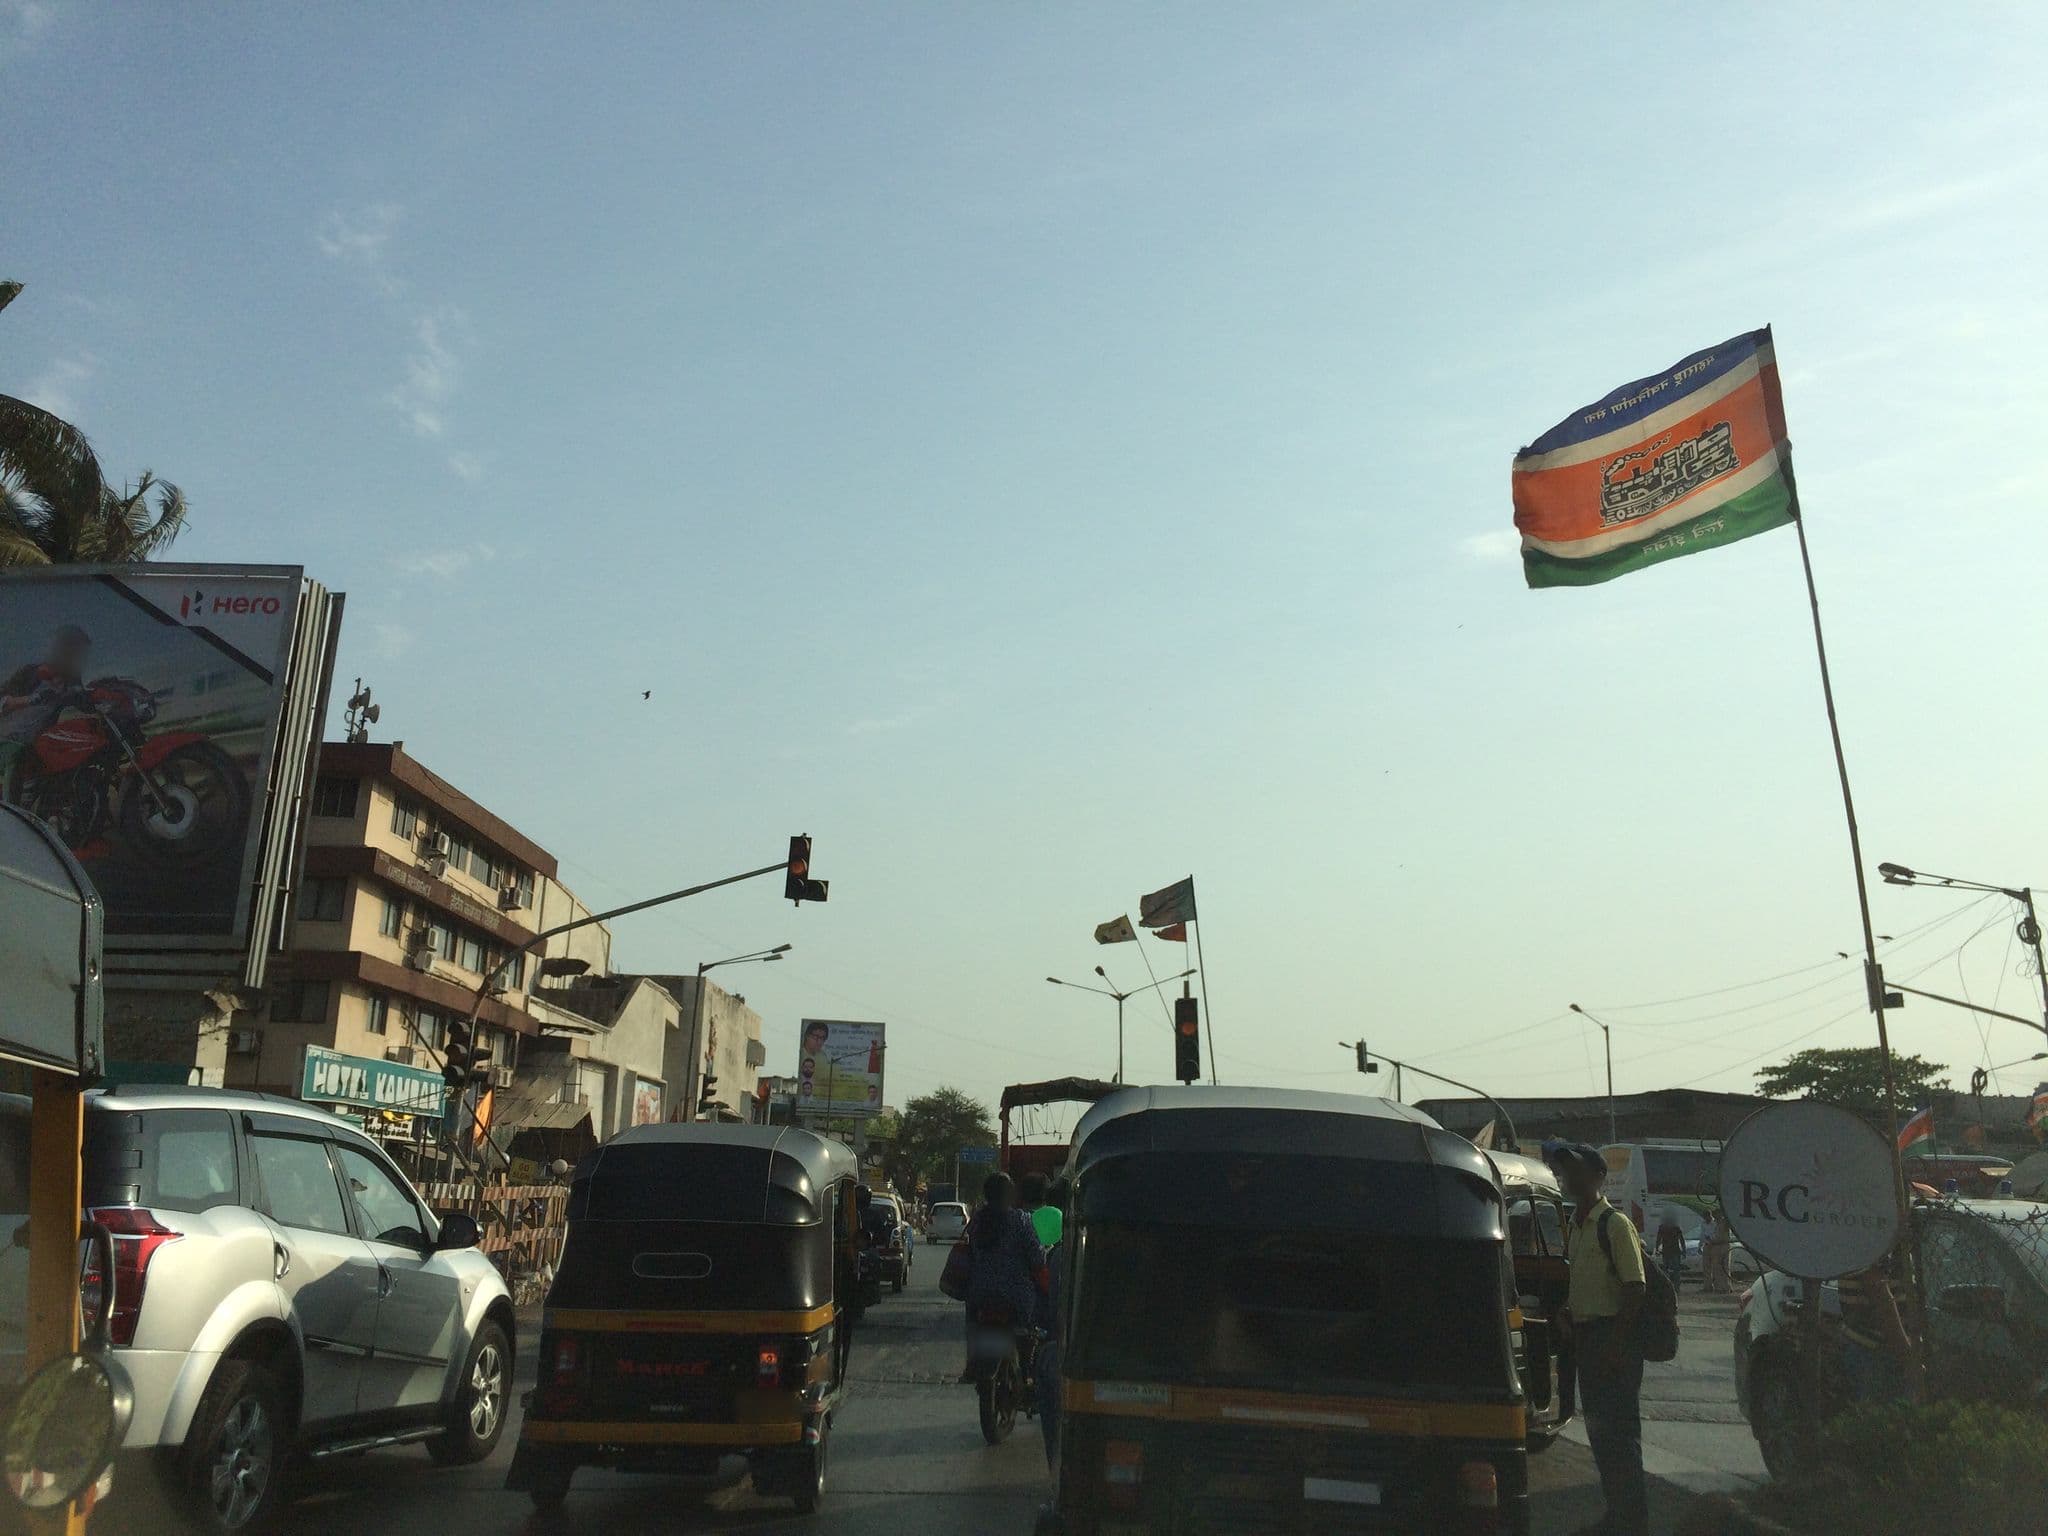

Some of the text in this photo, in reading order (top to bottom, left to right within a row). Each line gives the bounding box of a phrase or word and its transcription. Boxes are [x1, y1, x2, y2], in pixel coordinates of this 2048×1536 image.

[213, 595, 280, 614] Hero
[312, 1061, 442, 1110] HOTEL KAMRAN
[1739, 1180, 1888, 1229] RC GROUP
